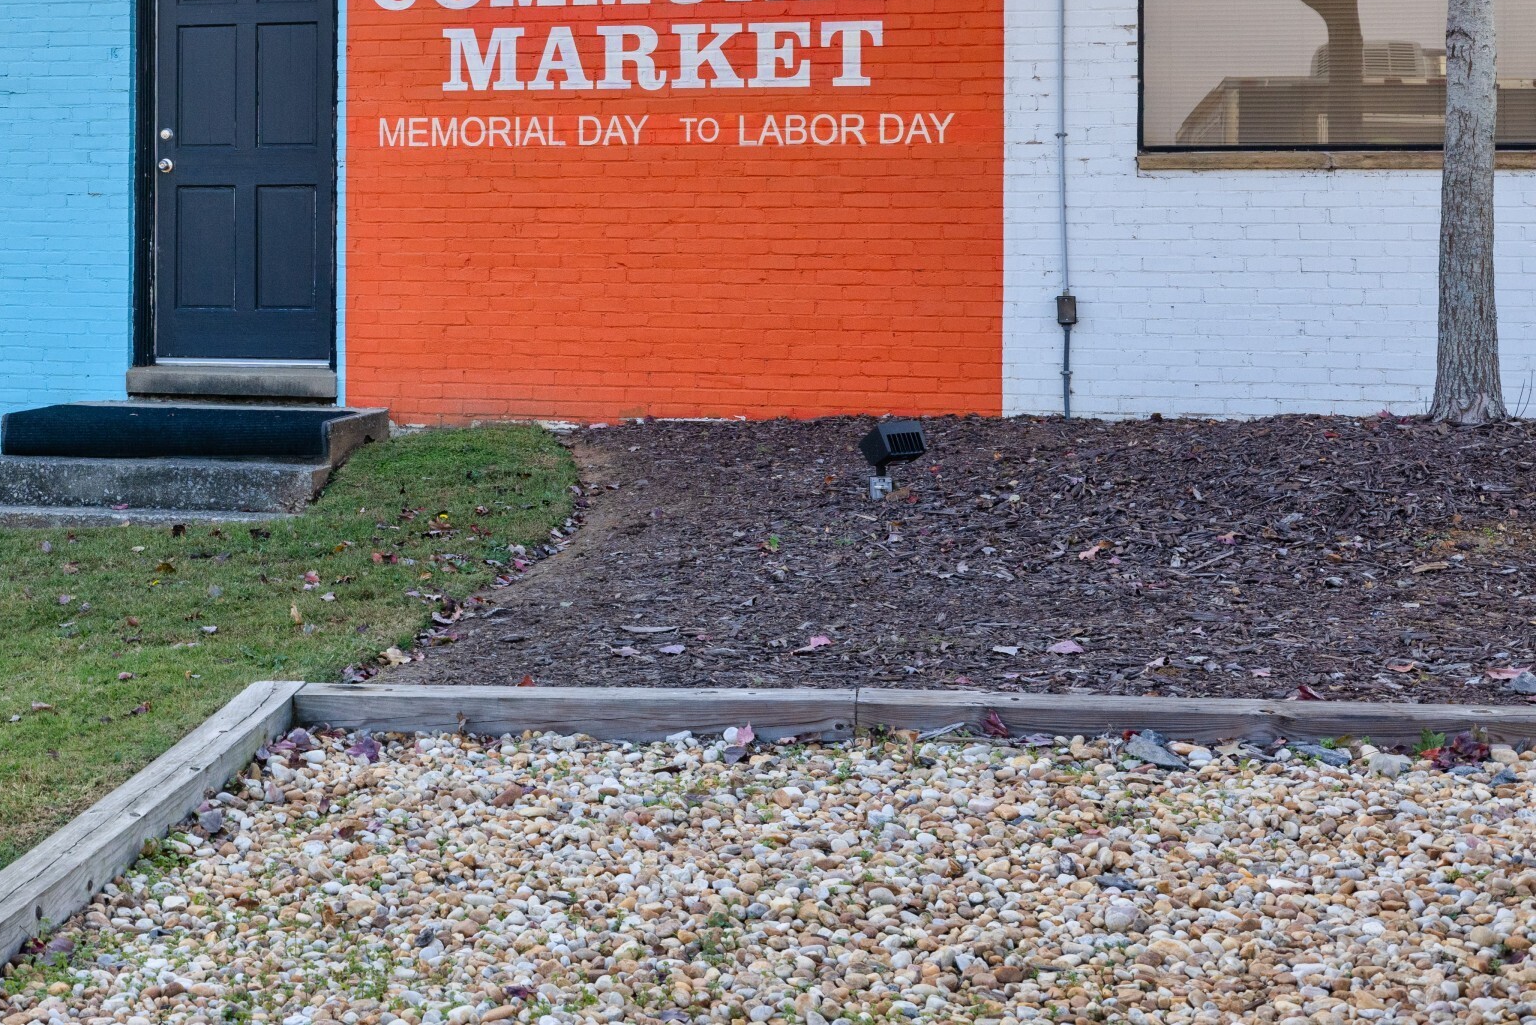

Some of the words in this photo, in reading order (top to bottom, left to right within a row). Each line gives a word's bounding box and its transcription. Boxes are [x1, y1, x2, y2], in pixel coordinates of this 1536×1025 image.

[442, 20, 884, 91] MARKET
[378, 114, 565, 147] MEMORIAL
[578, 113, 650, 147] DAY
[679, 117, 720, 143] TO
[738, 114, 865, 146] LABOR
[879, 112, 955, 145] DAY
